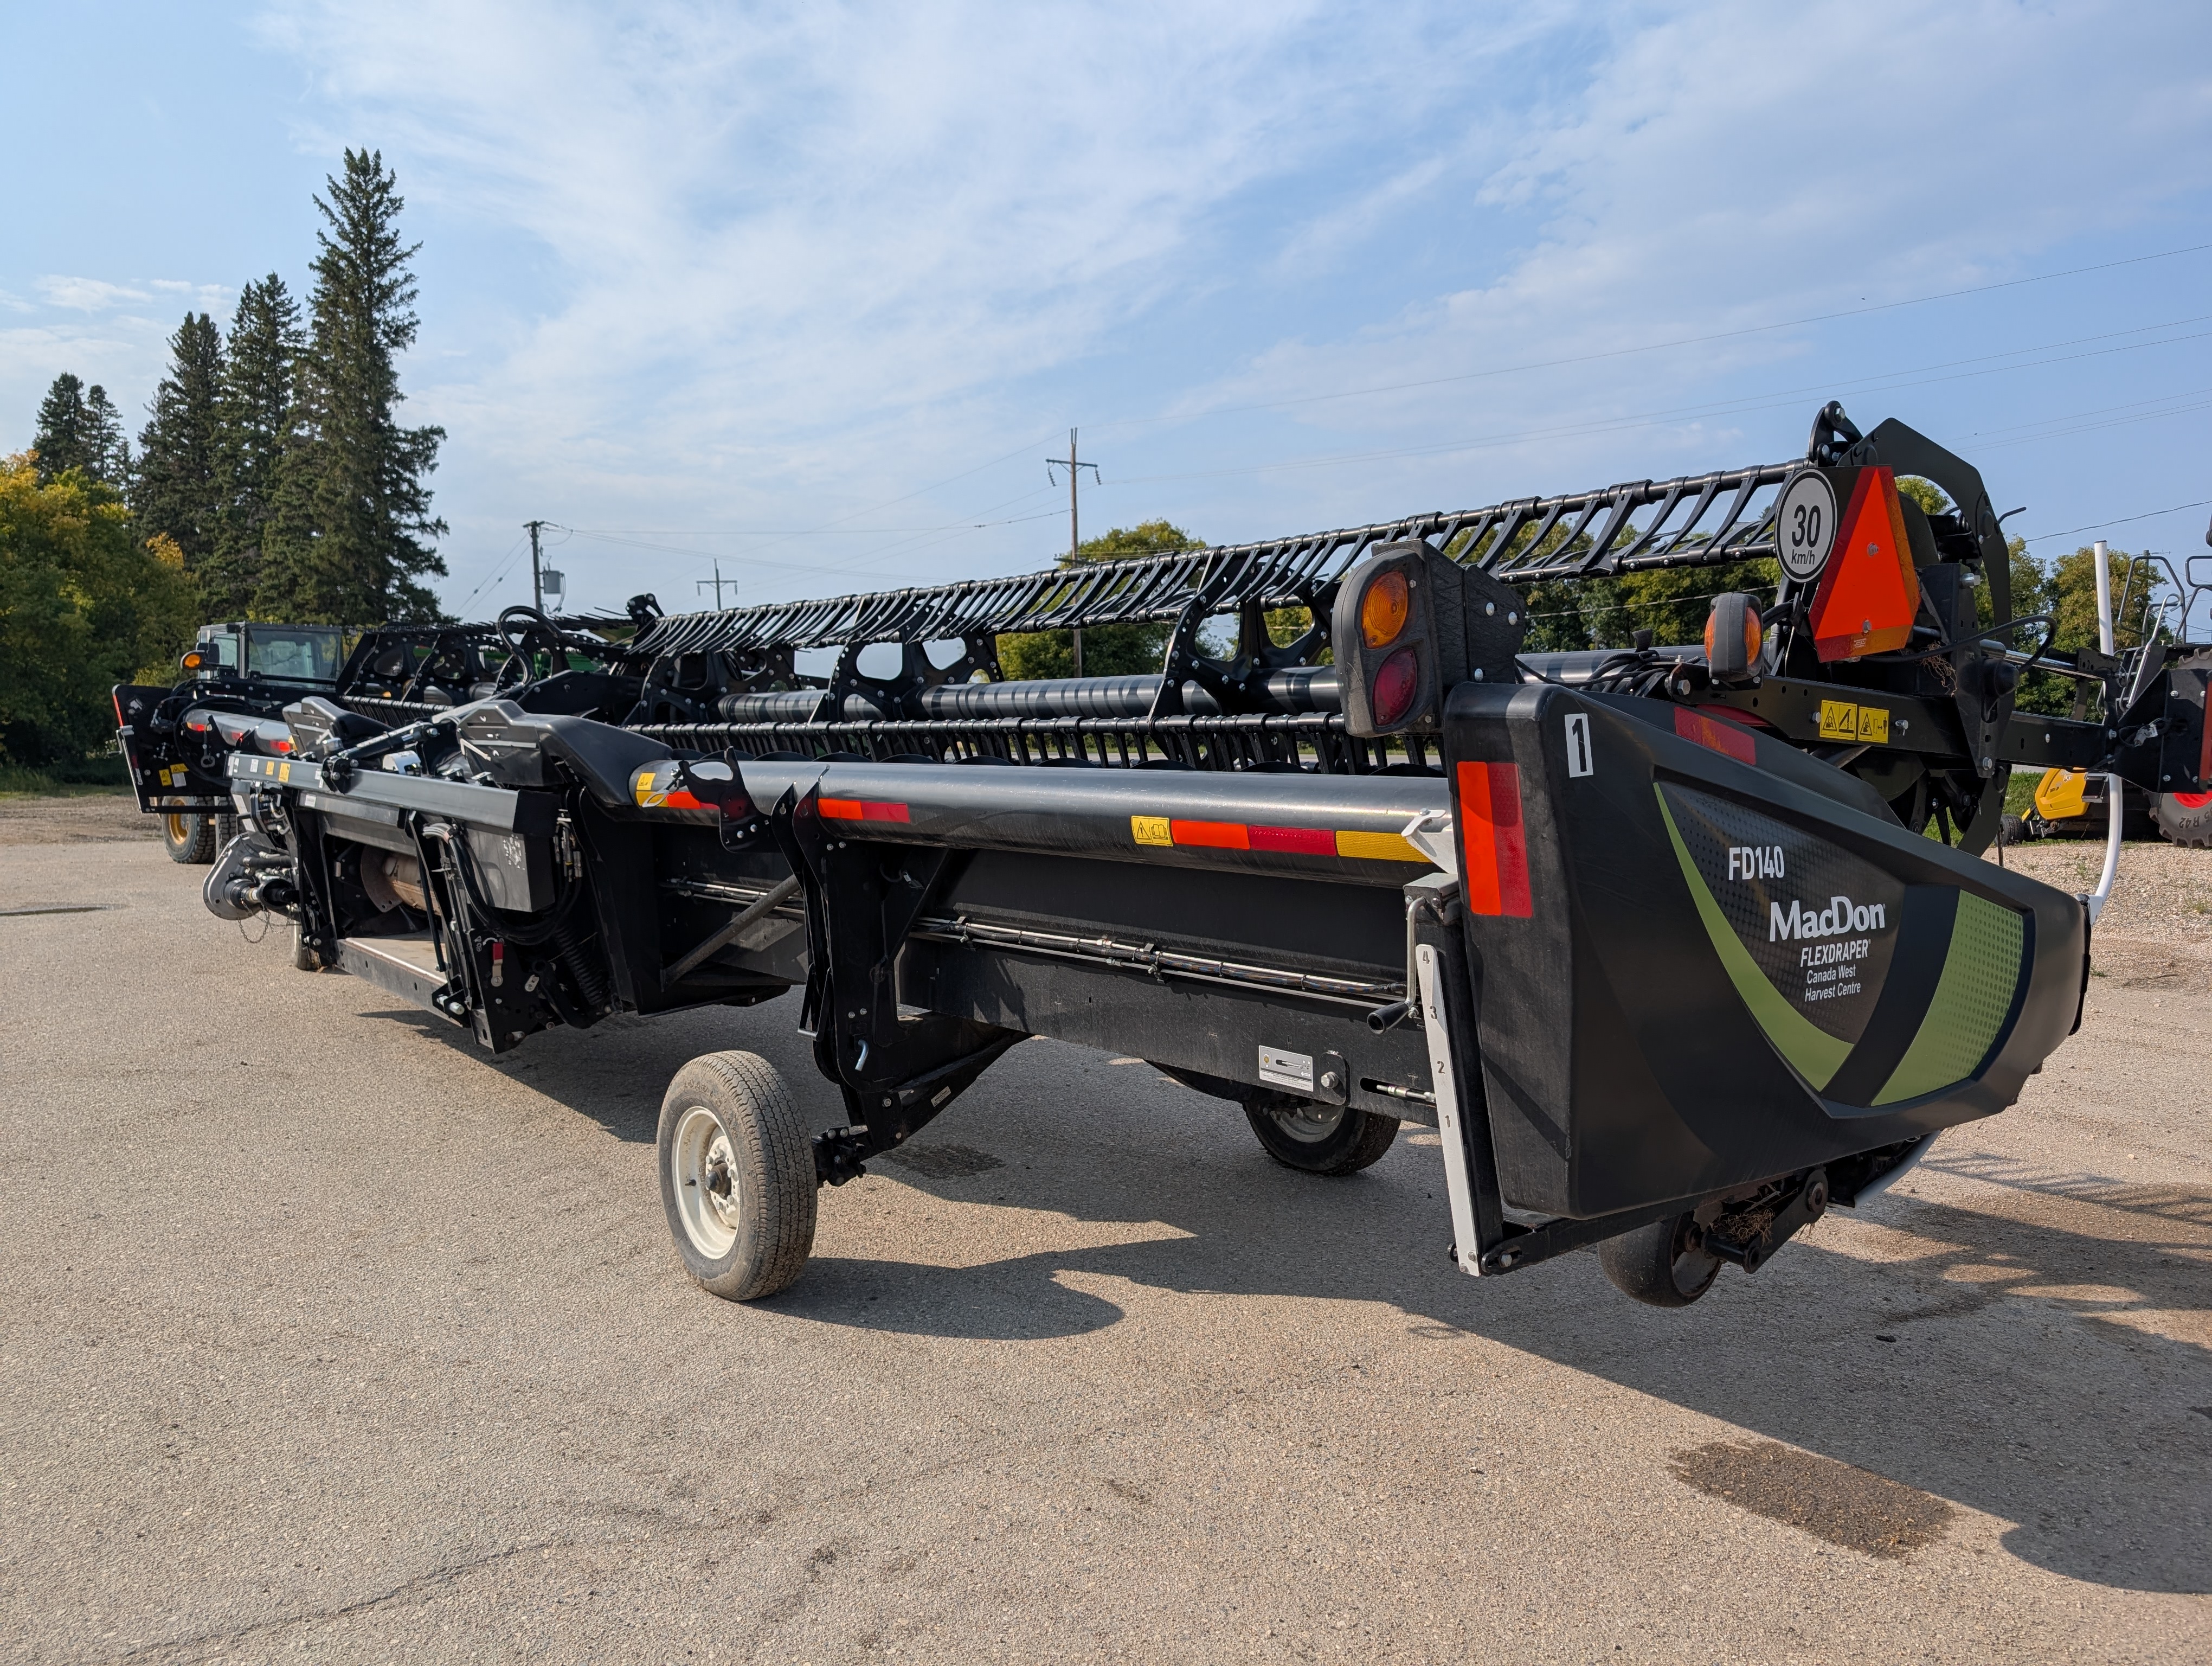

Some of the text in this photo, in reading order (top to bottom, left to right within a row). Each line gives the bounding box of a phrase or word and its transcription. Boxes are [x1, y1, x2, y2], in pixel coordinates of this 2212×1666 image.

[1792, 504, 1821, 548] 30
[1791, 549, 1815, 565] km/h
[1572, 718, 1587, 772] 1
[2179, 816, 2200, 829] R42
[1728, 846, 1785, 880] FD140
[1770, 896, 1885, 942] MacDon
[1422, 951, 1430, 964] 4
[1800, 939, 1869, 967] FLEXDRAPER
[1806, 964, 1856, 984] Canada West
[1804, 981, 1861, 1002] Harvest Centre
[1430, 1005, 1438, 1020] 3
[1437, 1061, 1445, 1074] 2
[1444, 1114, 1451, 1128] 1
